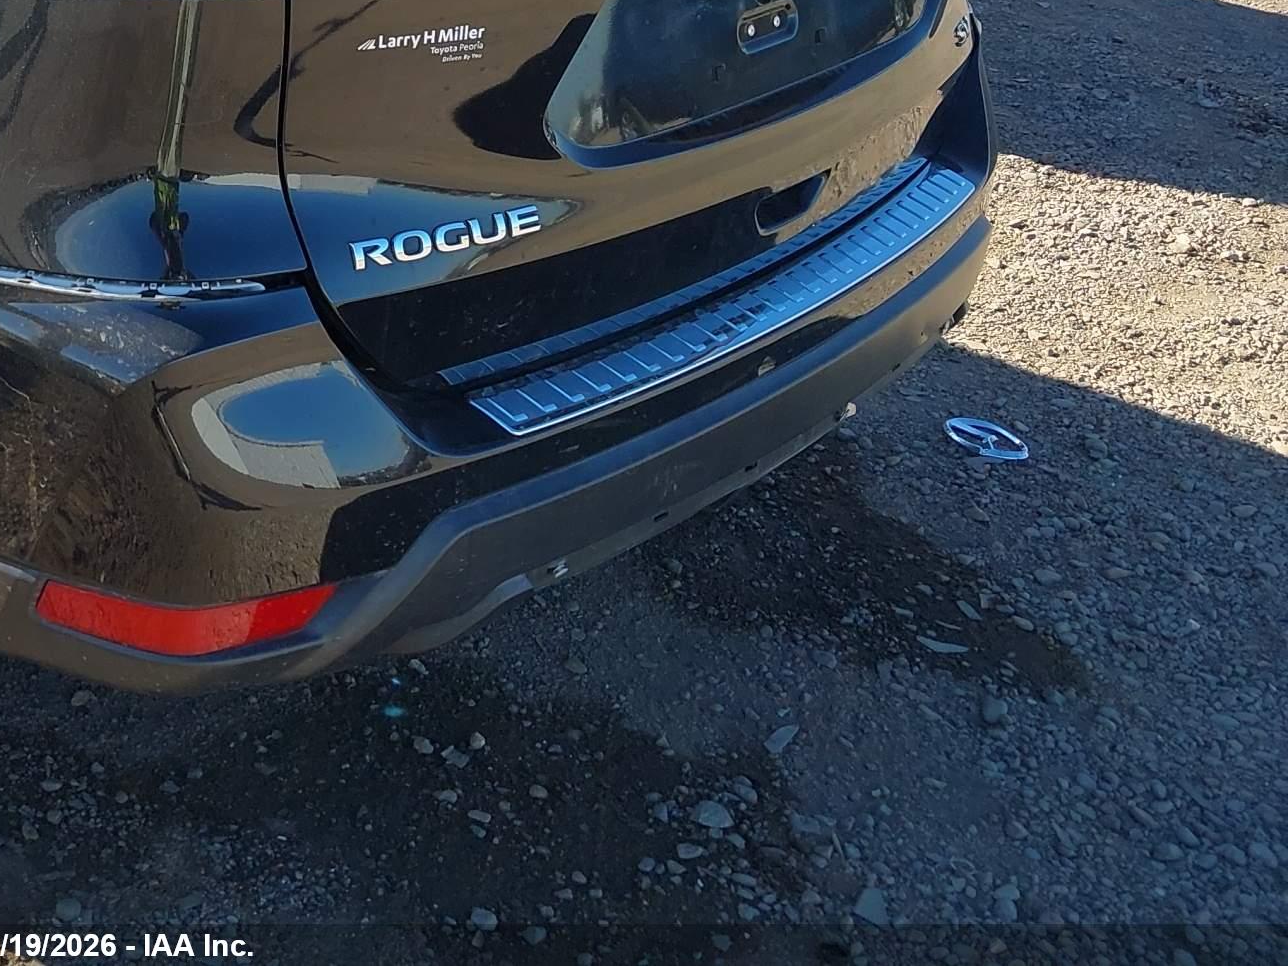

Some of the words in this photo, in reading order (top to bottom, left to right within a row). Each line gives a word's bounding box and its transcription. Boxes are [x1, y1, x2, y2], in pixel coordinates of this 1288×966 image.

[378, 35, 421, 49] Larry
[423, 30, 436, 44] H
[438, 25, 485, 43] Miller
[430, 44, 457, 55] Toyota
[459, 41, 483, 51] Peoria
[348, 205, 541, 271] ROGUE
